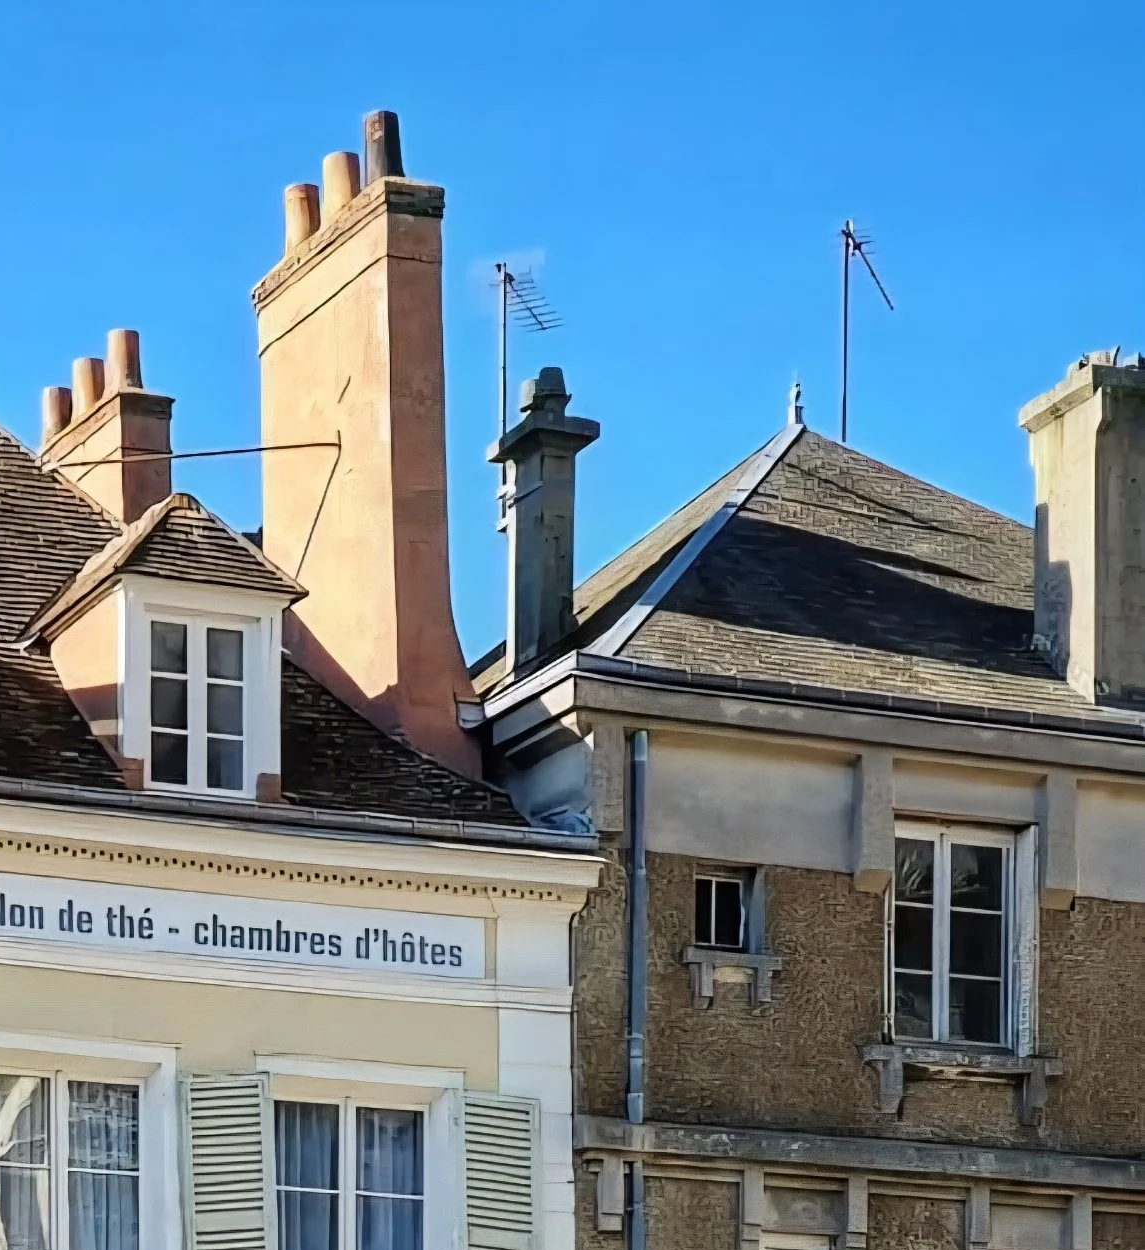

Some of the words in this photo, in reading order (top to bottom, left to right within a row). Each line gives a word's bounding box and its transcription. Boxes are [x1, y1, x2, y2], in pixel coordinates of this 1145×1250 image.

[58, 899, 93, 934] de
[106, 905, 154, 940] thé
[194, 914, 342, 957] chambres
